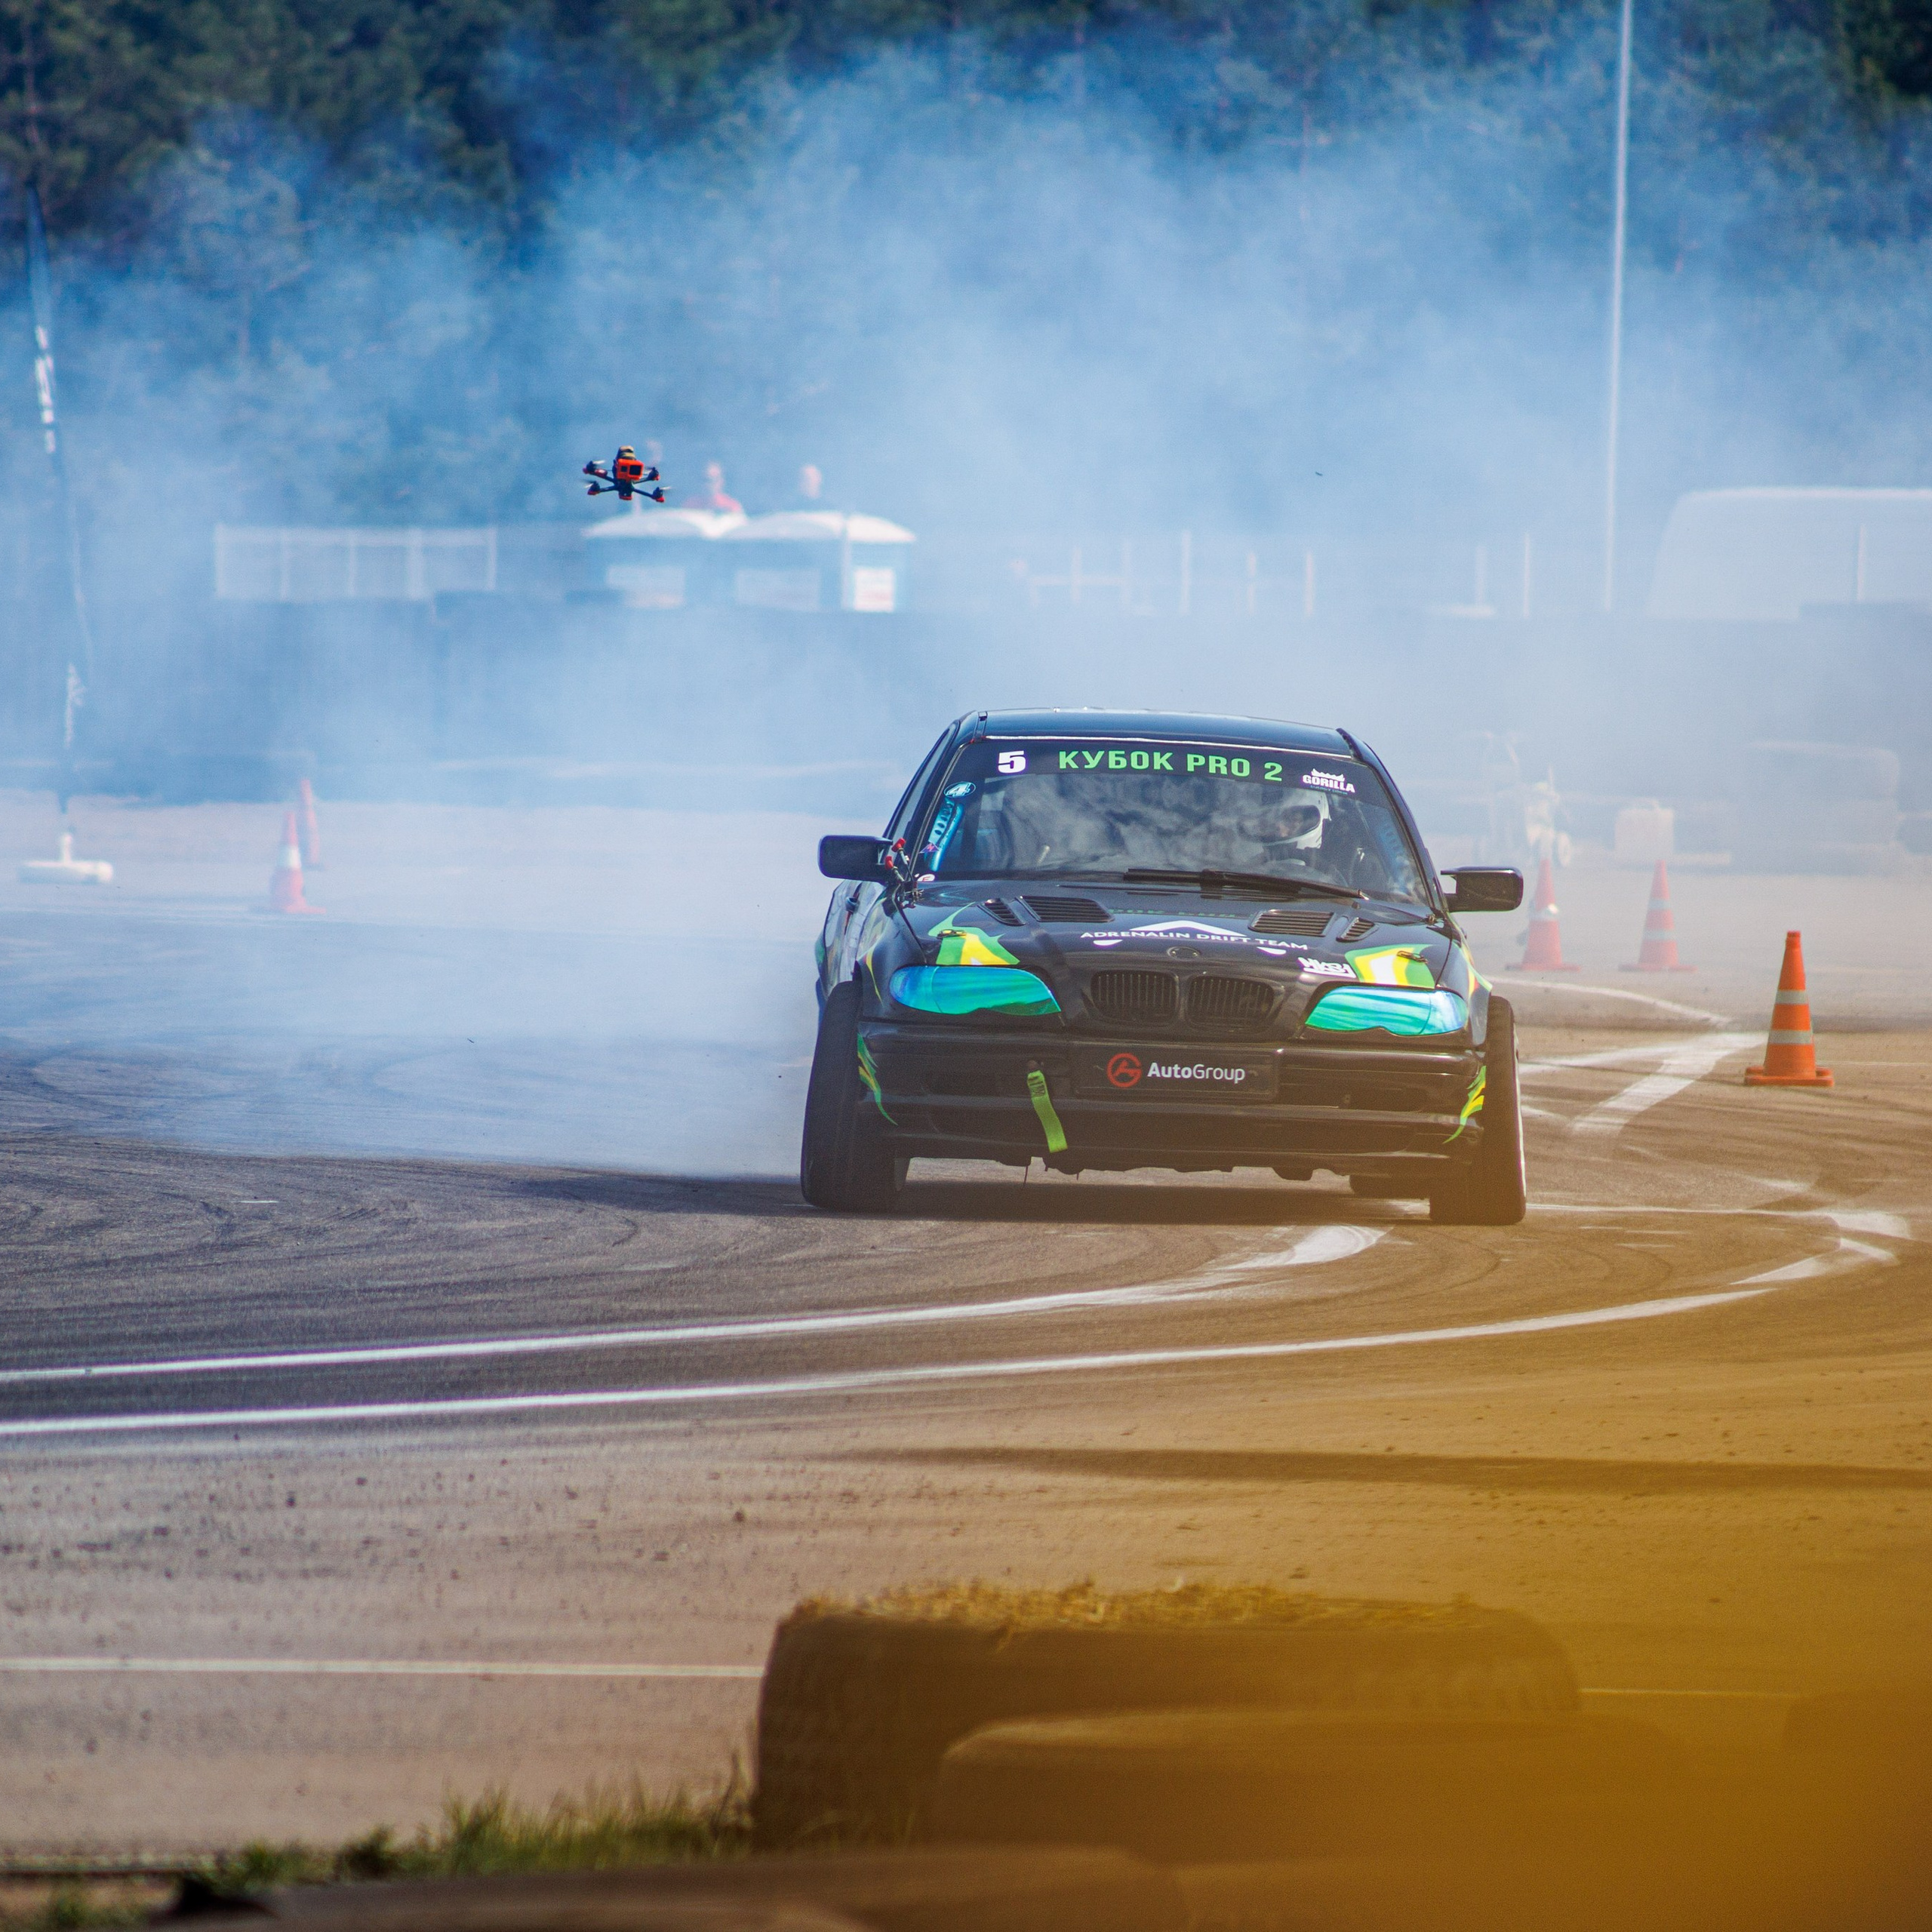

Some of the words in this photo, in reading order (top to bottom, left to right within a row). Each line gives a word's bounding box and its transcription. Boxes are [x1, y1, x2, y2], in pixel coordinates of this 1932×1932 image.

[997, 750, 1027, 774] 5
[1058, 750, 1174, 771] КУБОК
[1186, 753, 1251, 777] PRO
[1263, 761, 1283, 782] 2
[1302, 774, 1356, 793] GORILLA
[1080, 931, 1191, 939] ADRENALIN
[1196, 933, 1251, 943] DRIFT
[1254, 938, 1309, 951] TEAM
[1146, 1062, 1246, 1084] AutoGroup
